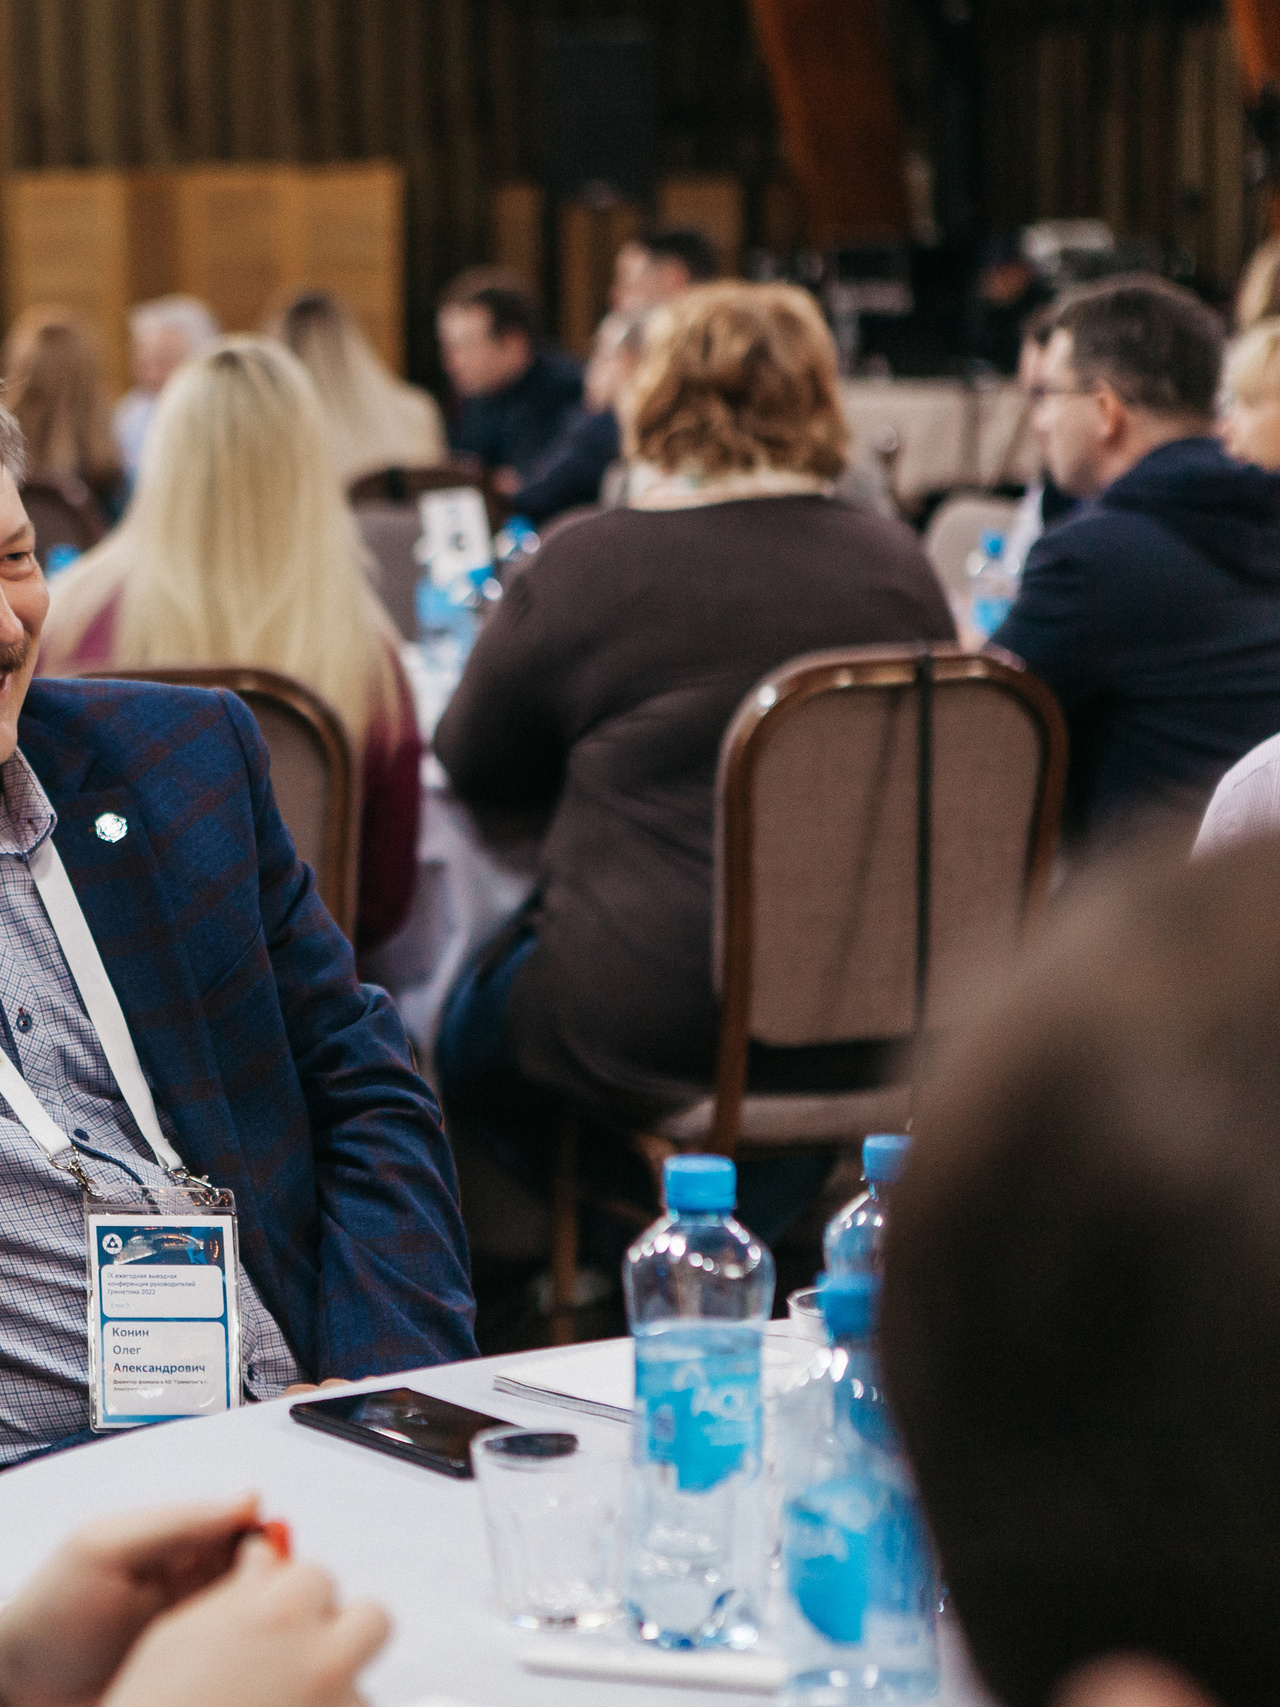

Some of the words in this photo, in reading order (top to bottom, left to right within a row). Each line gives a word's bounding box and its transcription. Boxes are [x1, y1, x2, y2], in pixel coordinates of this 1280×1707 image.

[112, 1327, 150, 1337] Конин
[112, 1345, 142, 1355] Олег
[113, 1363, 206, 1375] Александрович
